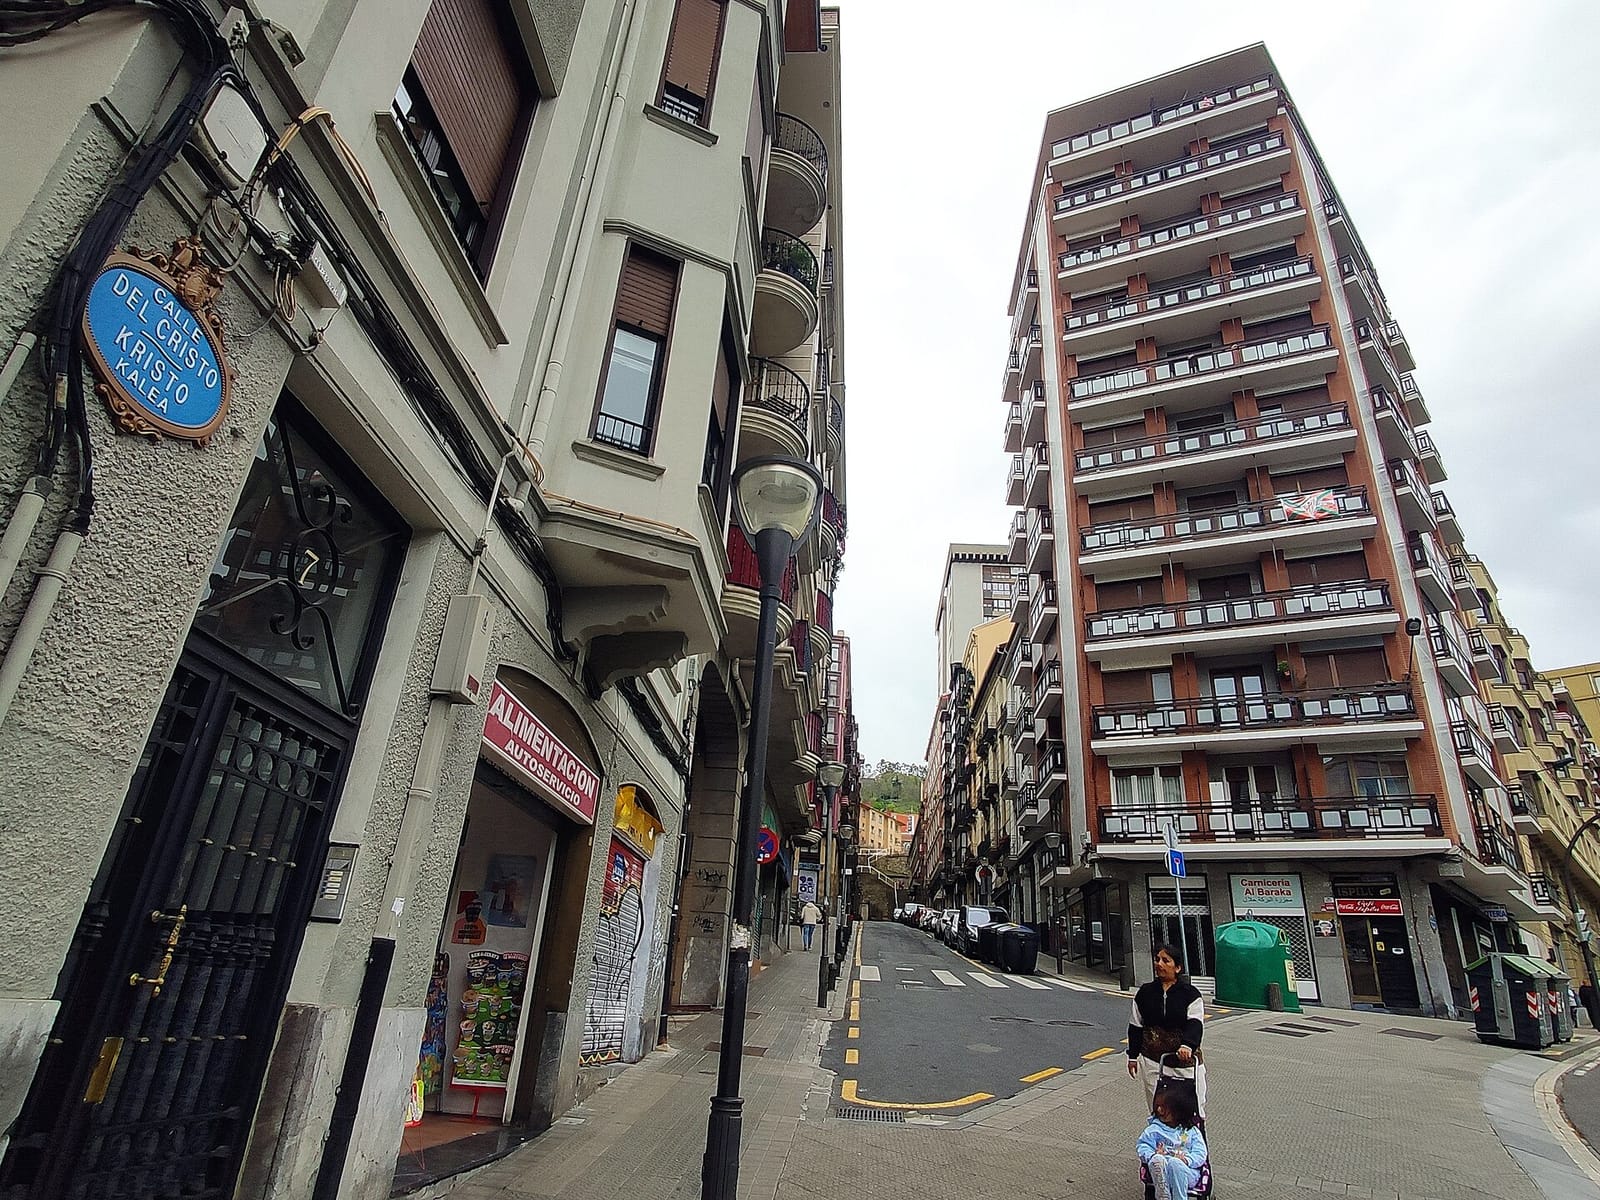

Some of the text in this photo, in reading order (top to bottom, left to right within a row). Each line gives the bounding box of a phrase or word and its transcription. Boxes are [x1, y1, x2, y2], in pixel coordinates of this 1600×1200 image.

[112, 272, 218, 389] DEL CRISTO
[153, 287, 204, 345] CALLE
[114, 325, 189, 404] KRISTO
[115, 357, 169, 414] KALEA
[298, 548, 321, 586] 7
[488, 692, 596, 799] ALIMENTACION
[504, 739, 581, 806] AUTOSERVICIO
[1245, 888, 1292, 896] Al Baraka
